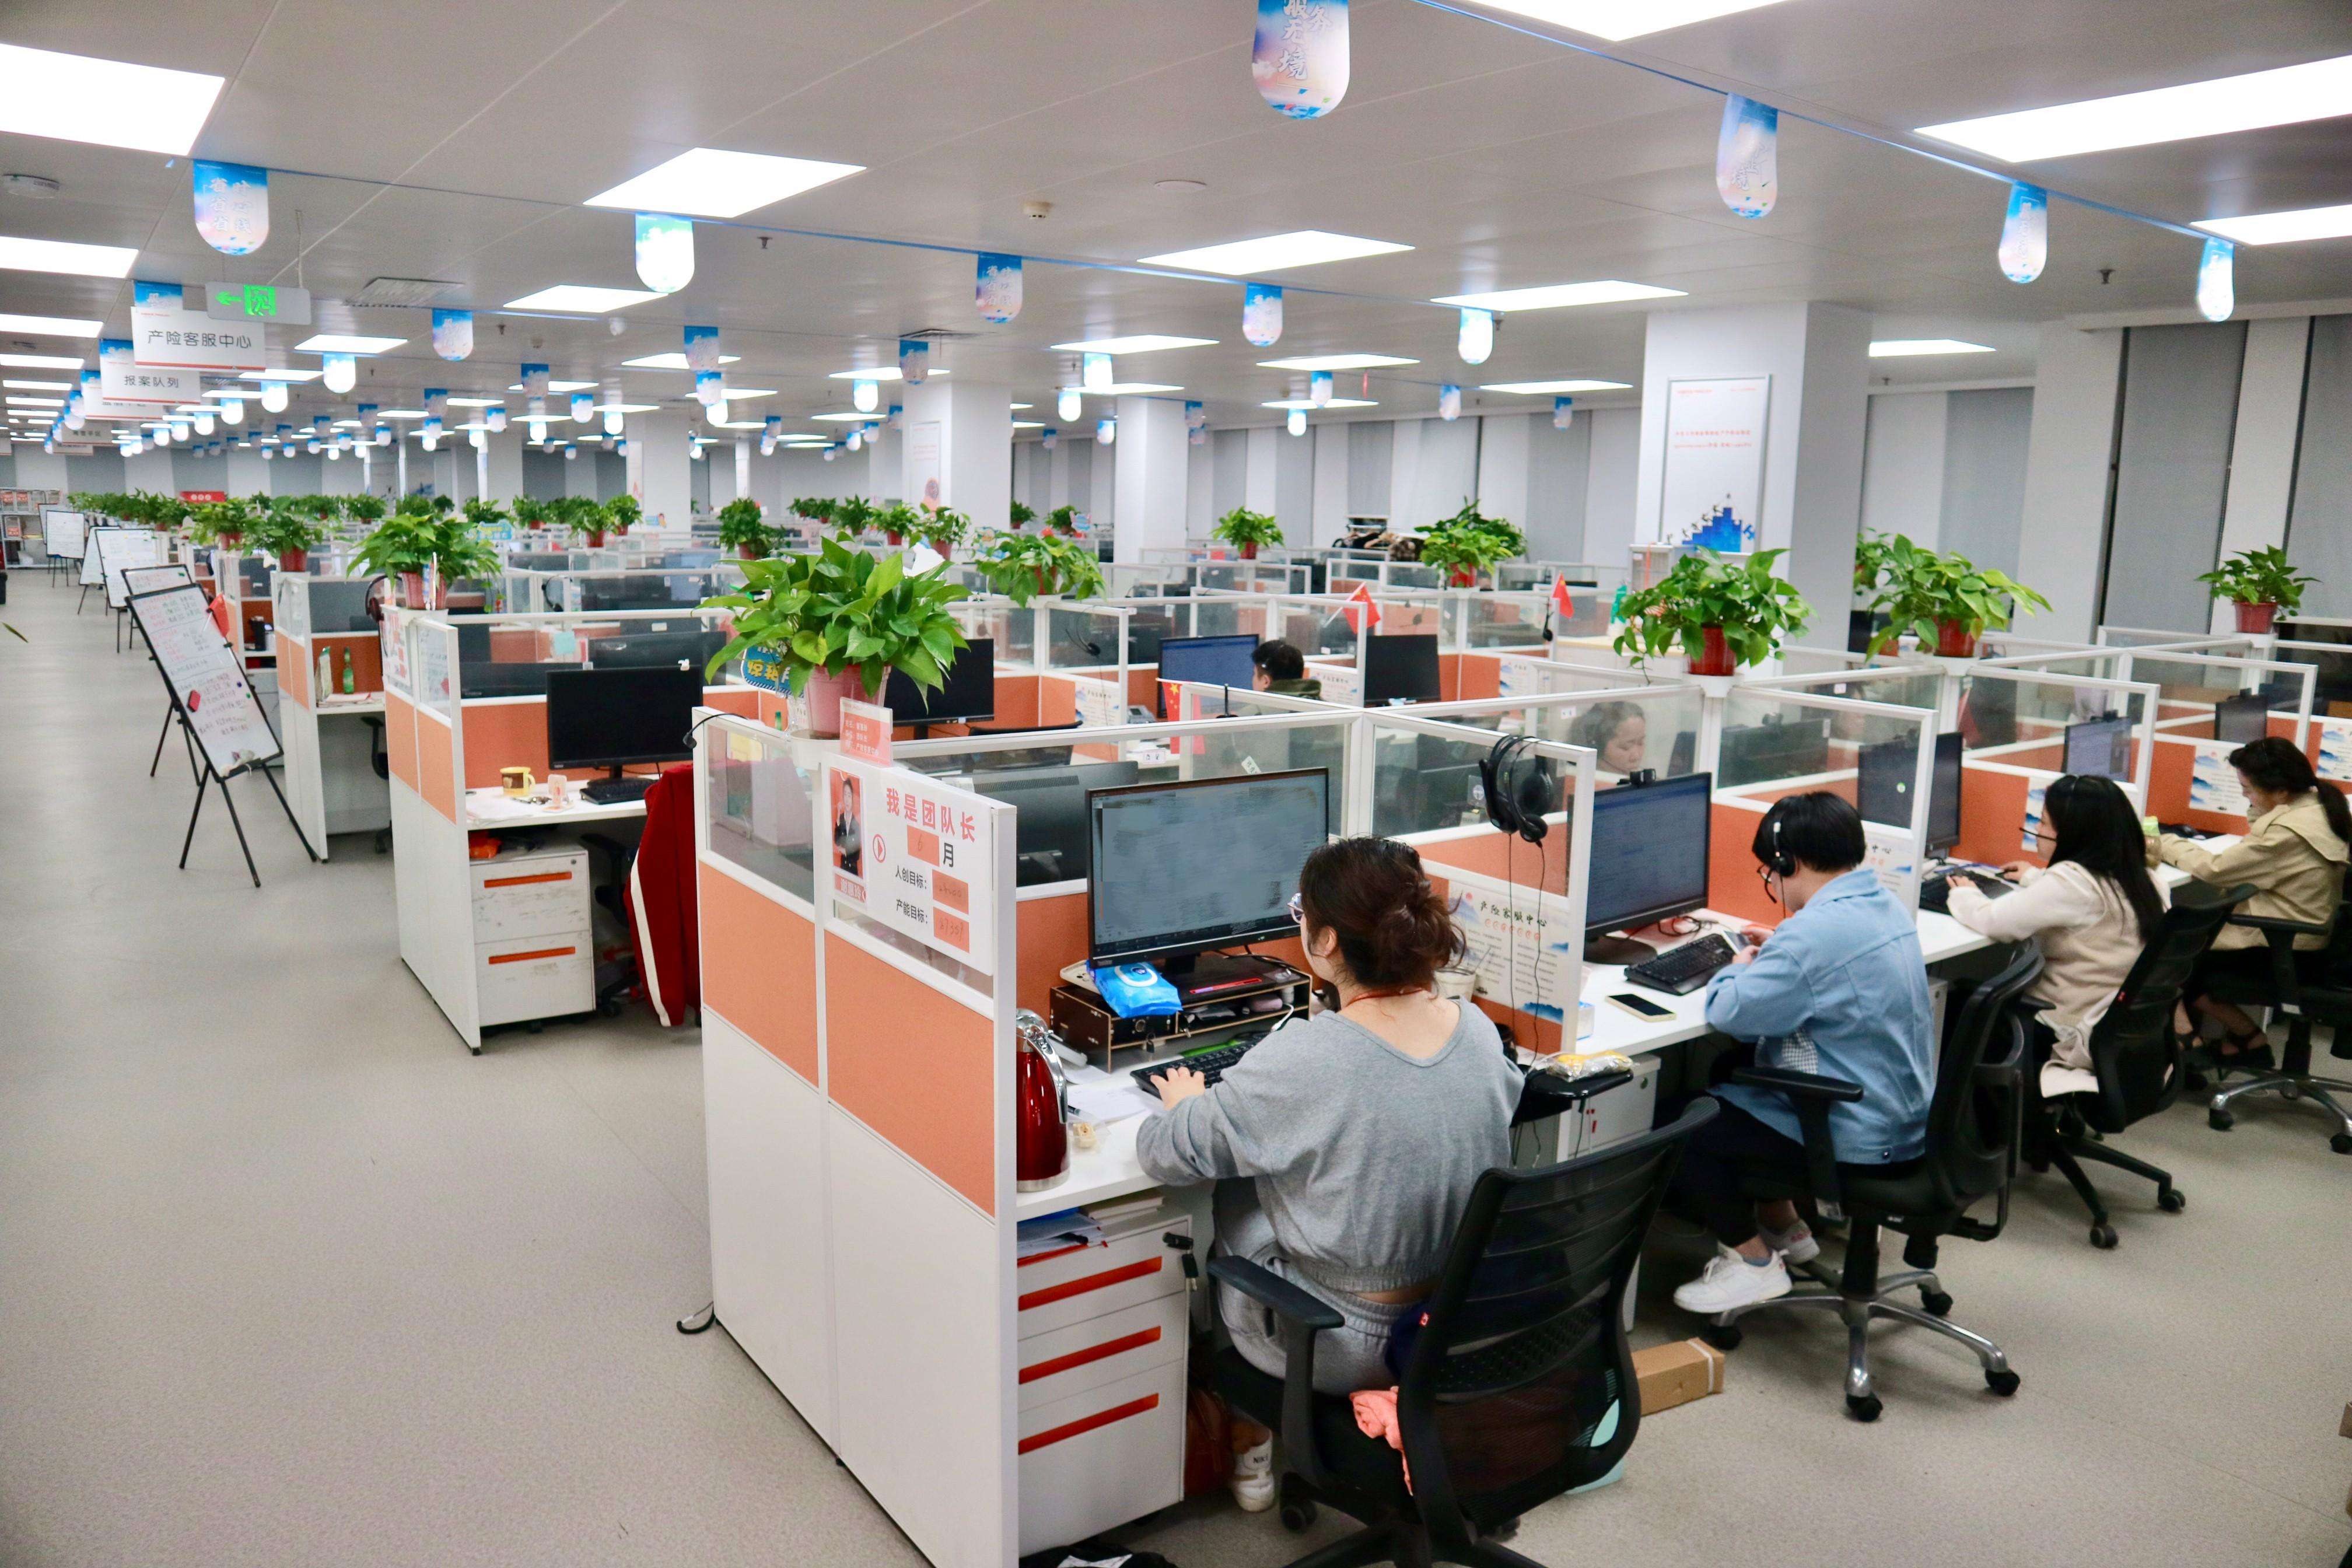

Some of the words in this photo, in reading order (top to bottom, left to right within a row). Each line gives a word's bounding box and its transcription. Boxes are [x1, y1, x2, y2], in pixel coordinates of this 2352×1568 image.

[148, 330, 251, 348] 产险客服中心
[124, 374, 179, 388] 报案队列
[886, 788, 975, 842] 我是团队长
[943, 842, 954, 867] 月
[895, 865, 927, 890] 人创目标：
[896, 899, 928, 924] 产能目标：
[1480, 900, 1548, 927] 产险客服中心
